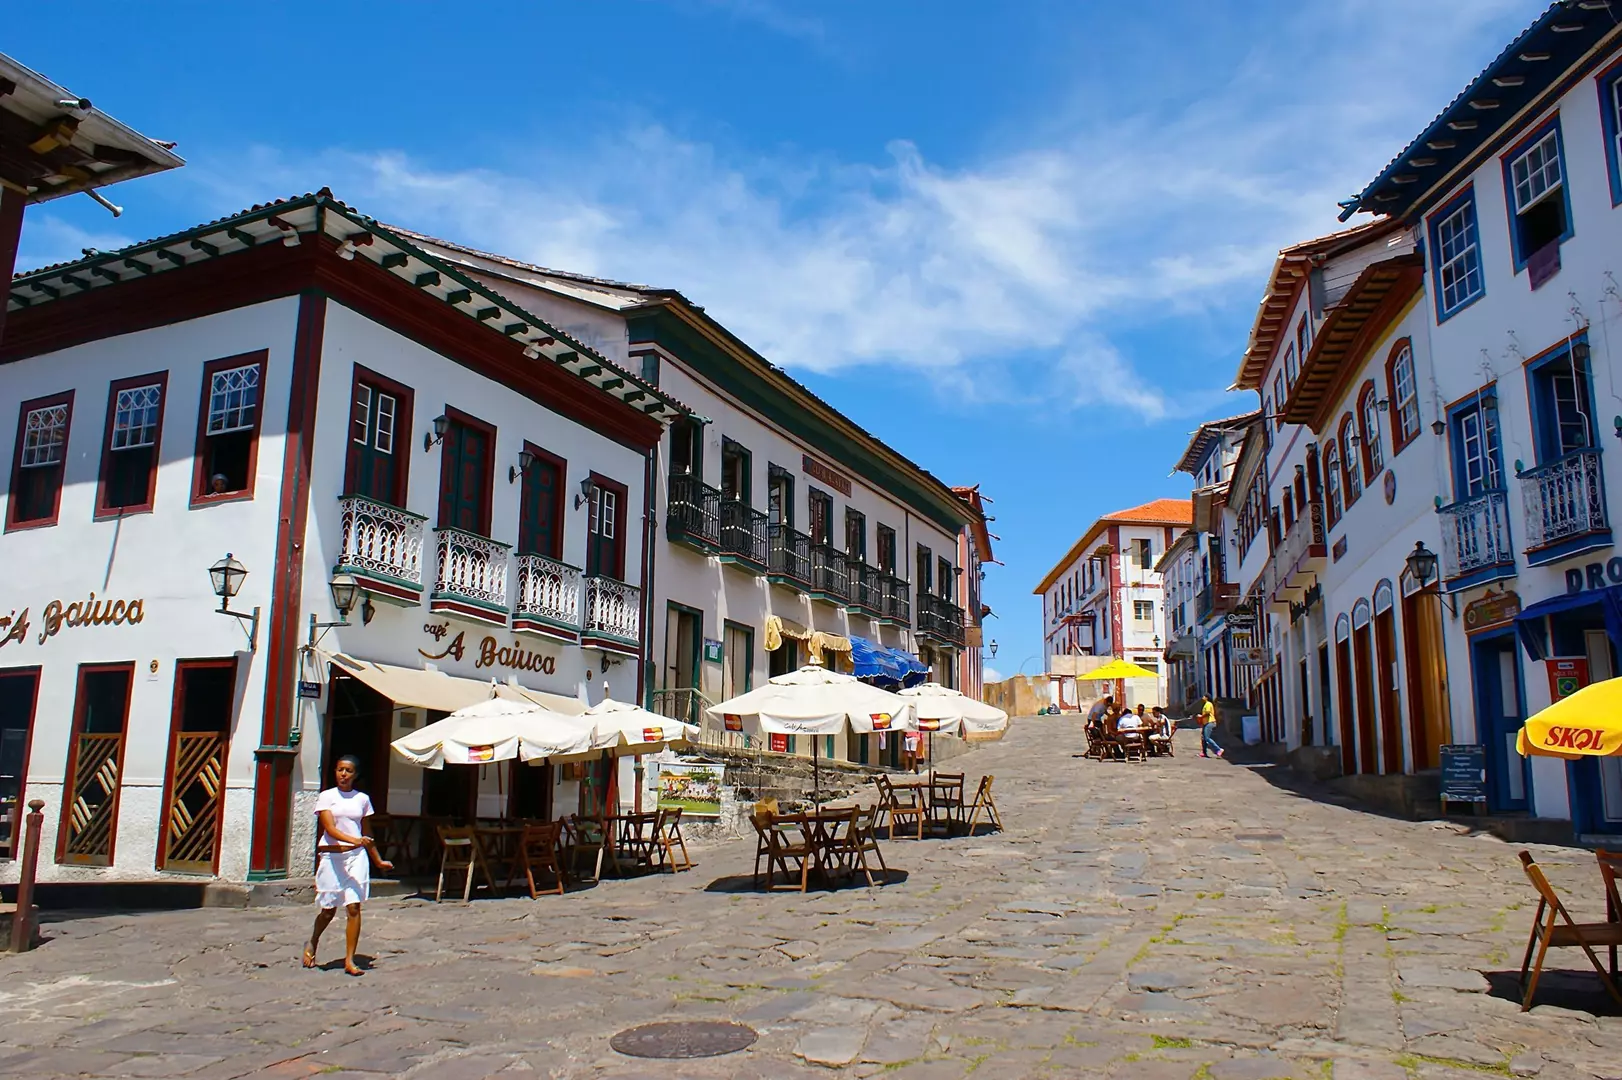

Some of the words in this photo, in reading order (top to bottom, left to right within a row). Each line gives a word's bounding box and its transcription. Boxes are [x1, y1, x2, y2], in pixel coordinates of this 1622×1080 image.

[1565, 556, 1622, 594] DRO
[39, 592, 144, 645] Baiuca
[423, 621, 450, 641] café
[475, 636, 556, 674] Baiuca
[1544, 726, 1605, 750] SKOL
